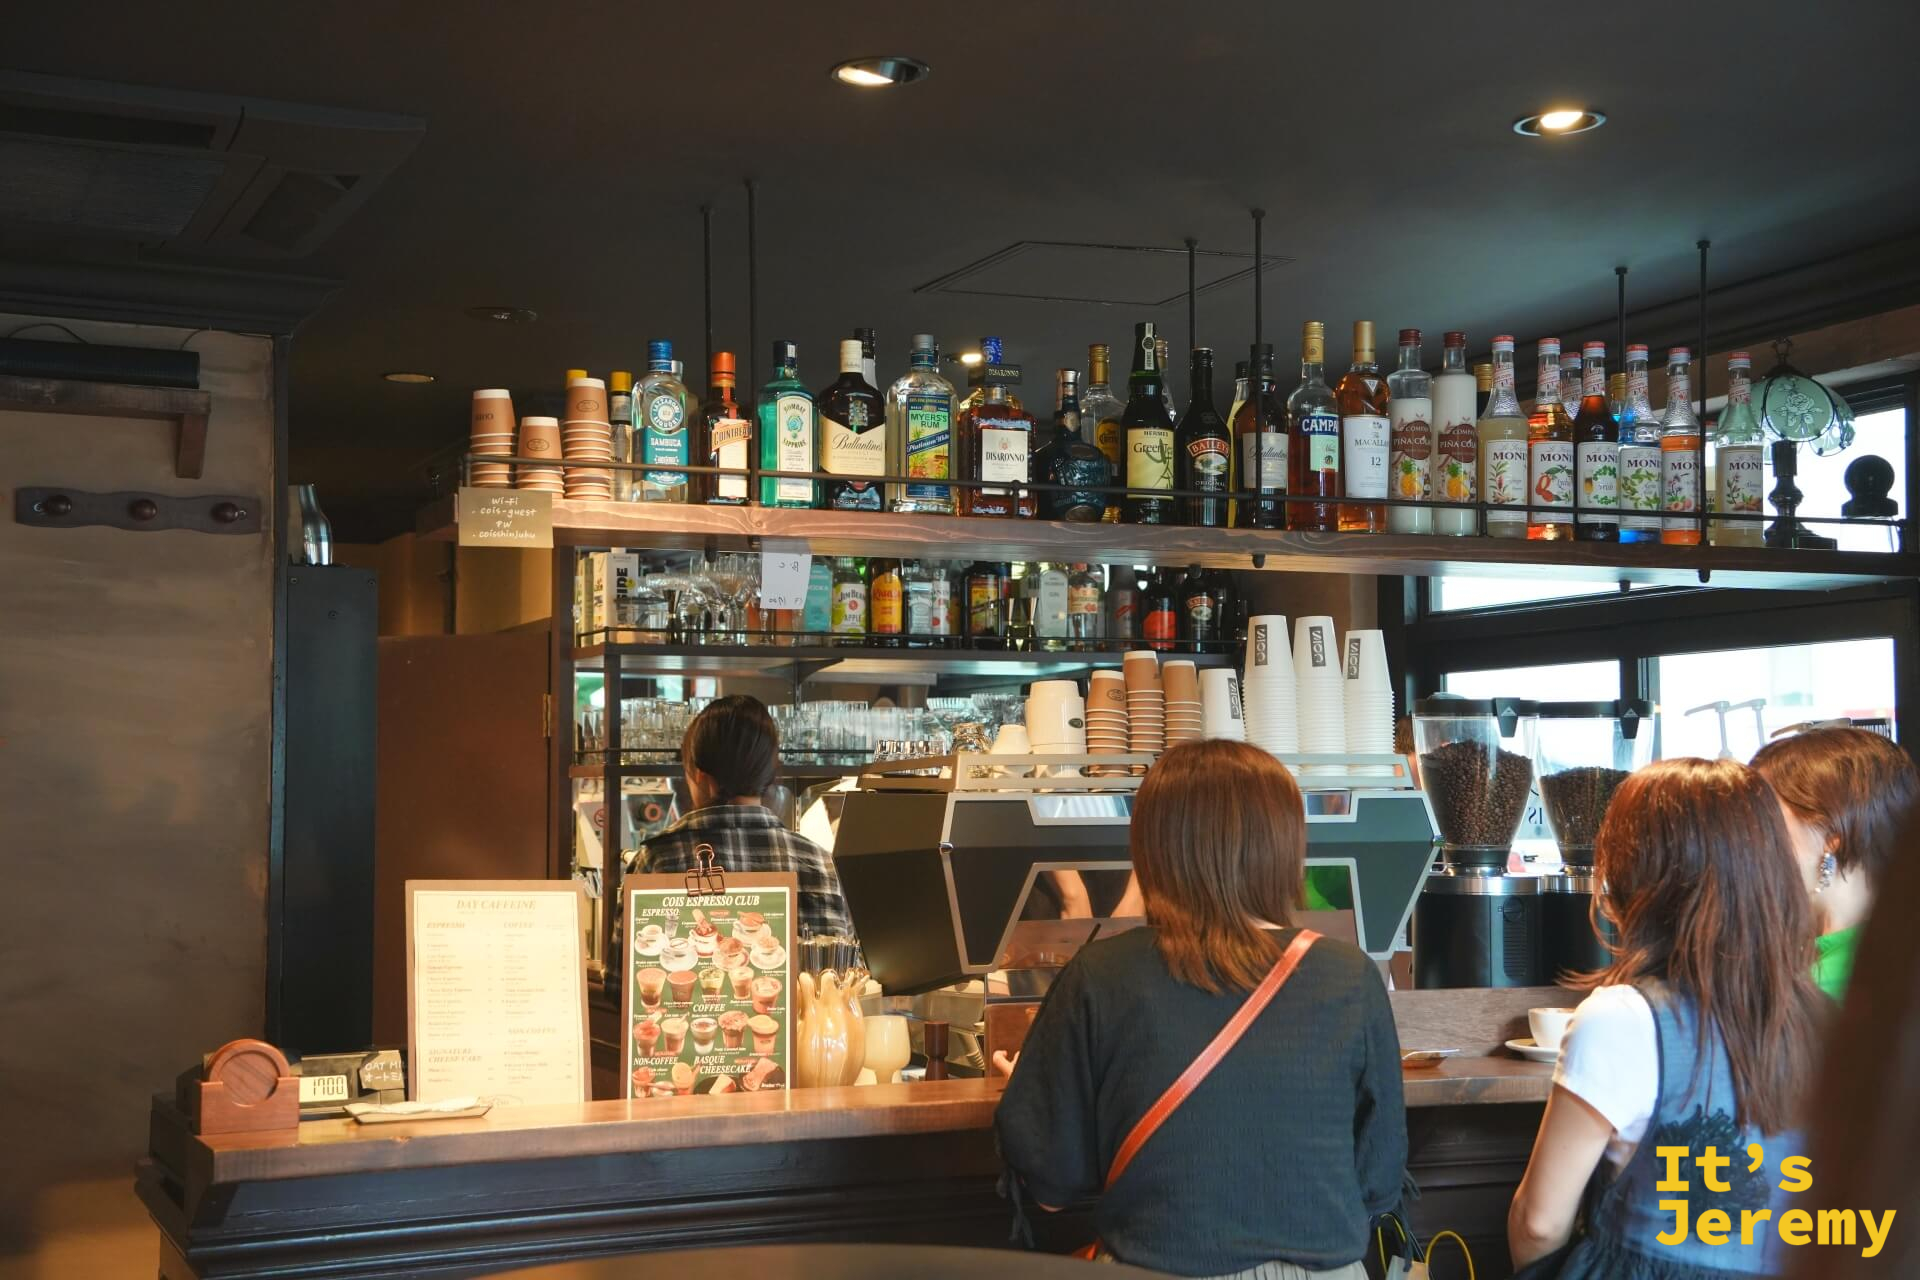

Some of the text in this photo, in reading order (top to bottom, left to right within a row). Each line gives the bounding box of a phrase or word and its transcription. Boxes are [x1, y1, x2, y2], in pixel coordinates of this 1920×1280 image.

[988, 369, 1019, 377] DISARONNO
[784, 403, 806, 413] BOMBAY
[910, 413, 948, 423] MYERS'S
[986, 452, 1024, 463] DISARONNO
[1370, 457, 1380, 466] 12
[844, 614, 862, 622] APPLE
[457, 900, 537, 911] DAY CAFFEINE
[662, 895, 760, 907] COIS ESPRESSO CLUB
[692, 1004, 726, 1012] COFFEE
[633, 1057, 679, 1066] NON-COFFEE
[694, 1055, 725, 1065] BASQUE
[365, 1063, 384, 1071] OAT
[699, 1064, 752, 1074] CHEESECAKE
[313, 1078, 344, 1096] 1700
